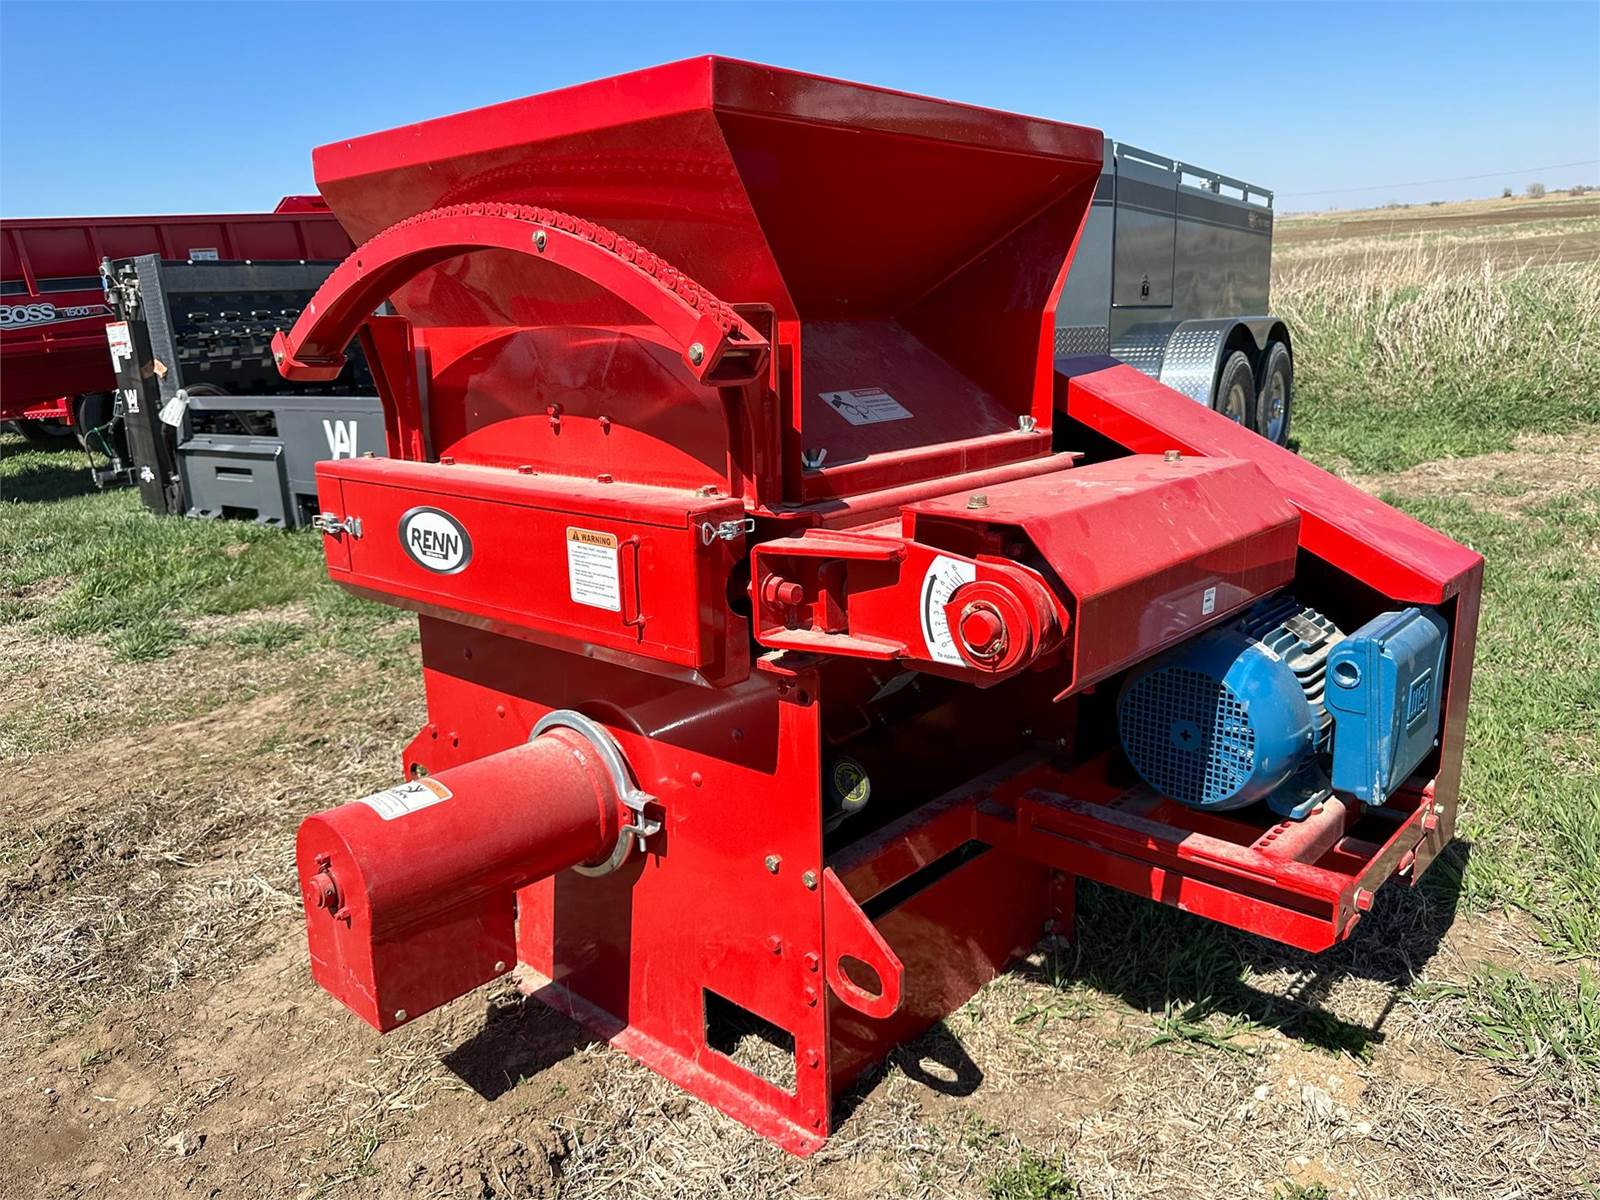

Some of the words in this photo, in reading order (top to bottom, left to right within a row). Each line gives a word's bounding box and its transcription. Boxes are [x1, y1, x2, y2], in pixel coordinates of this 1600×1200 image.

[0, 304, 55, 323] BOSS
[64, 307, 89, 317] 1500
[411, 527, 458, 560] RENN
[580, 533, 611, 546] WARNING
